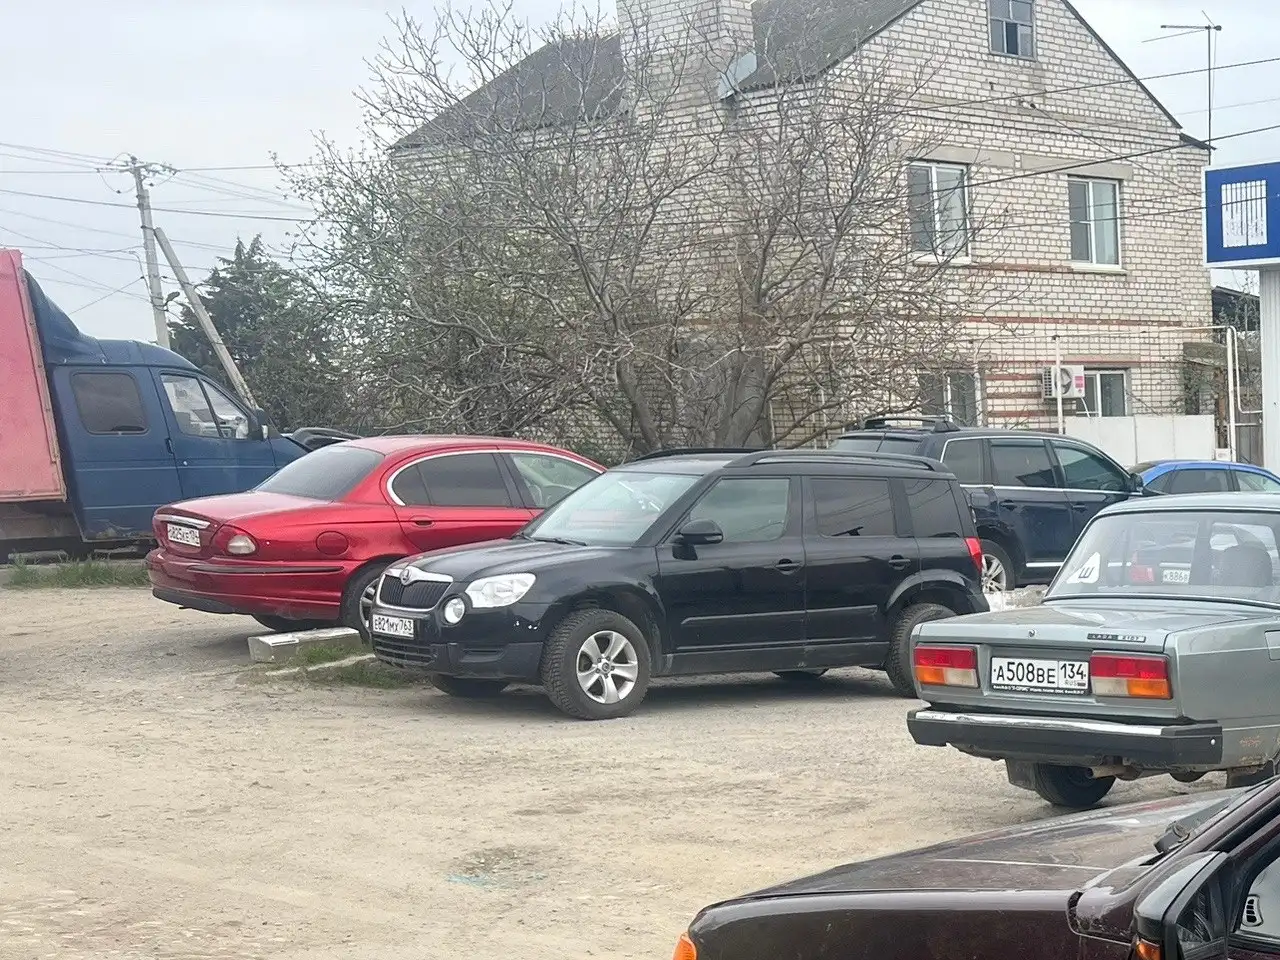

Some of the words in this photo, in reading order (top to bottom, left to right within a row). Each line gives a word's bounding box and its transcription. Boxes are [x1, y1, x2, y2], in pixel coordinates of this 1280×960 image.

[1078, 566, 1096, 579] Ш
[399, 619, 413, 631] 763
[996, 661, 1056, 684] А508ВЕ
[1060, 663, 1085, 680] 134
